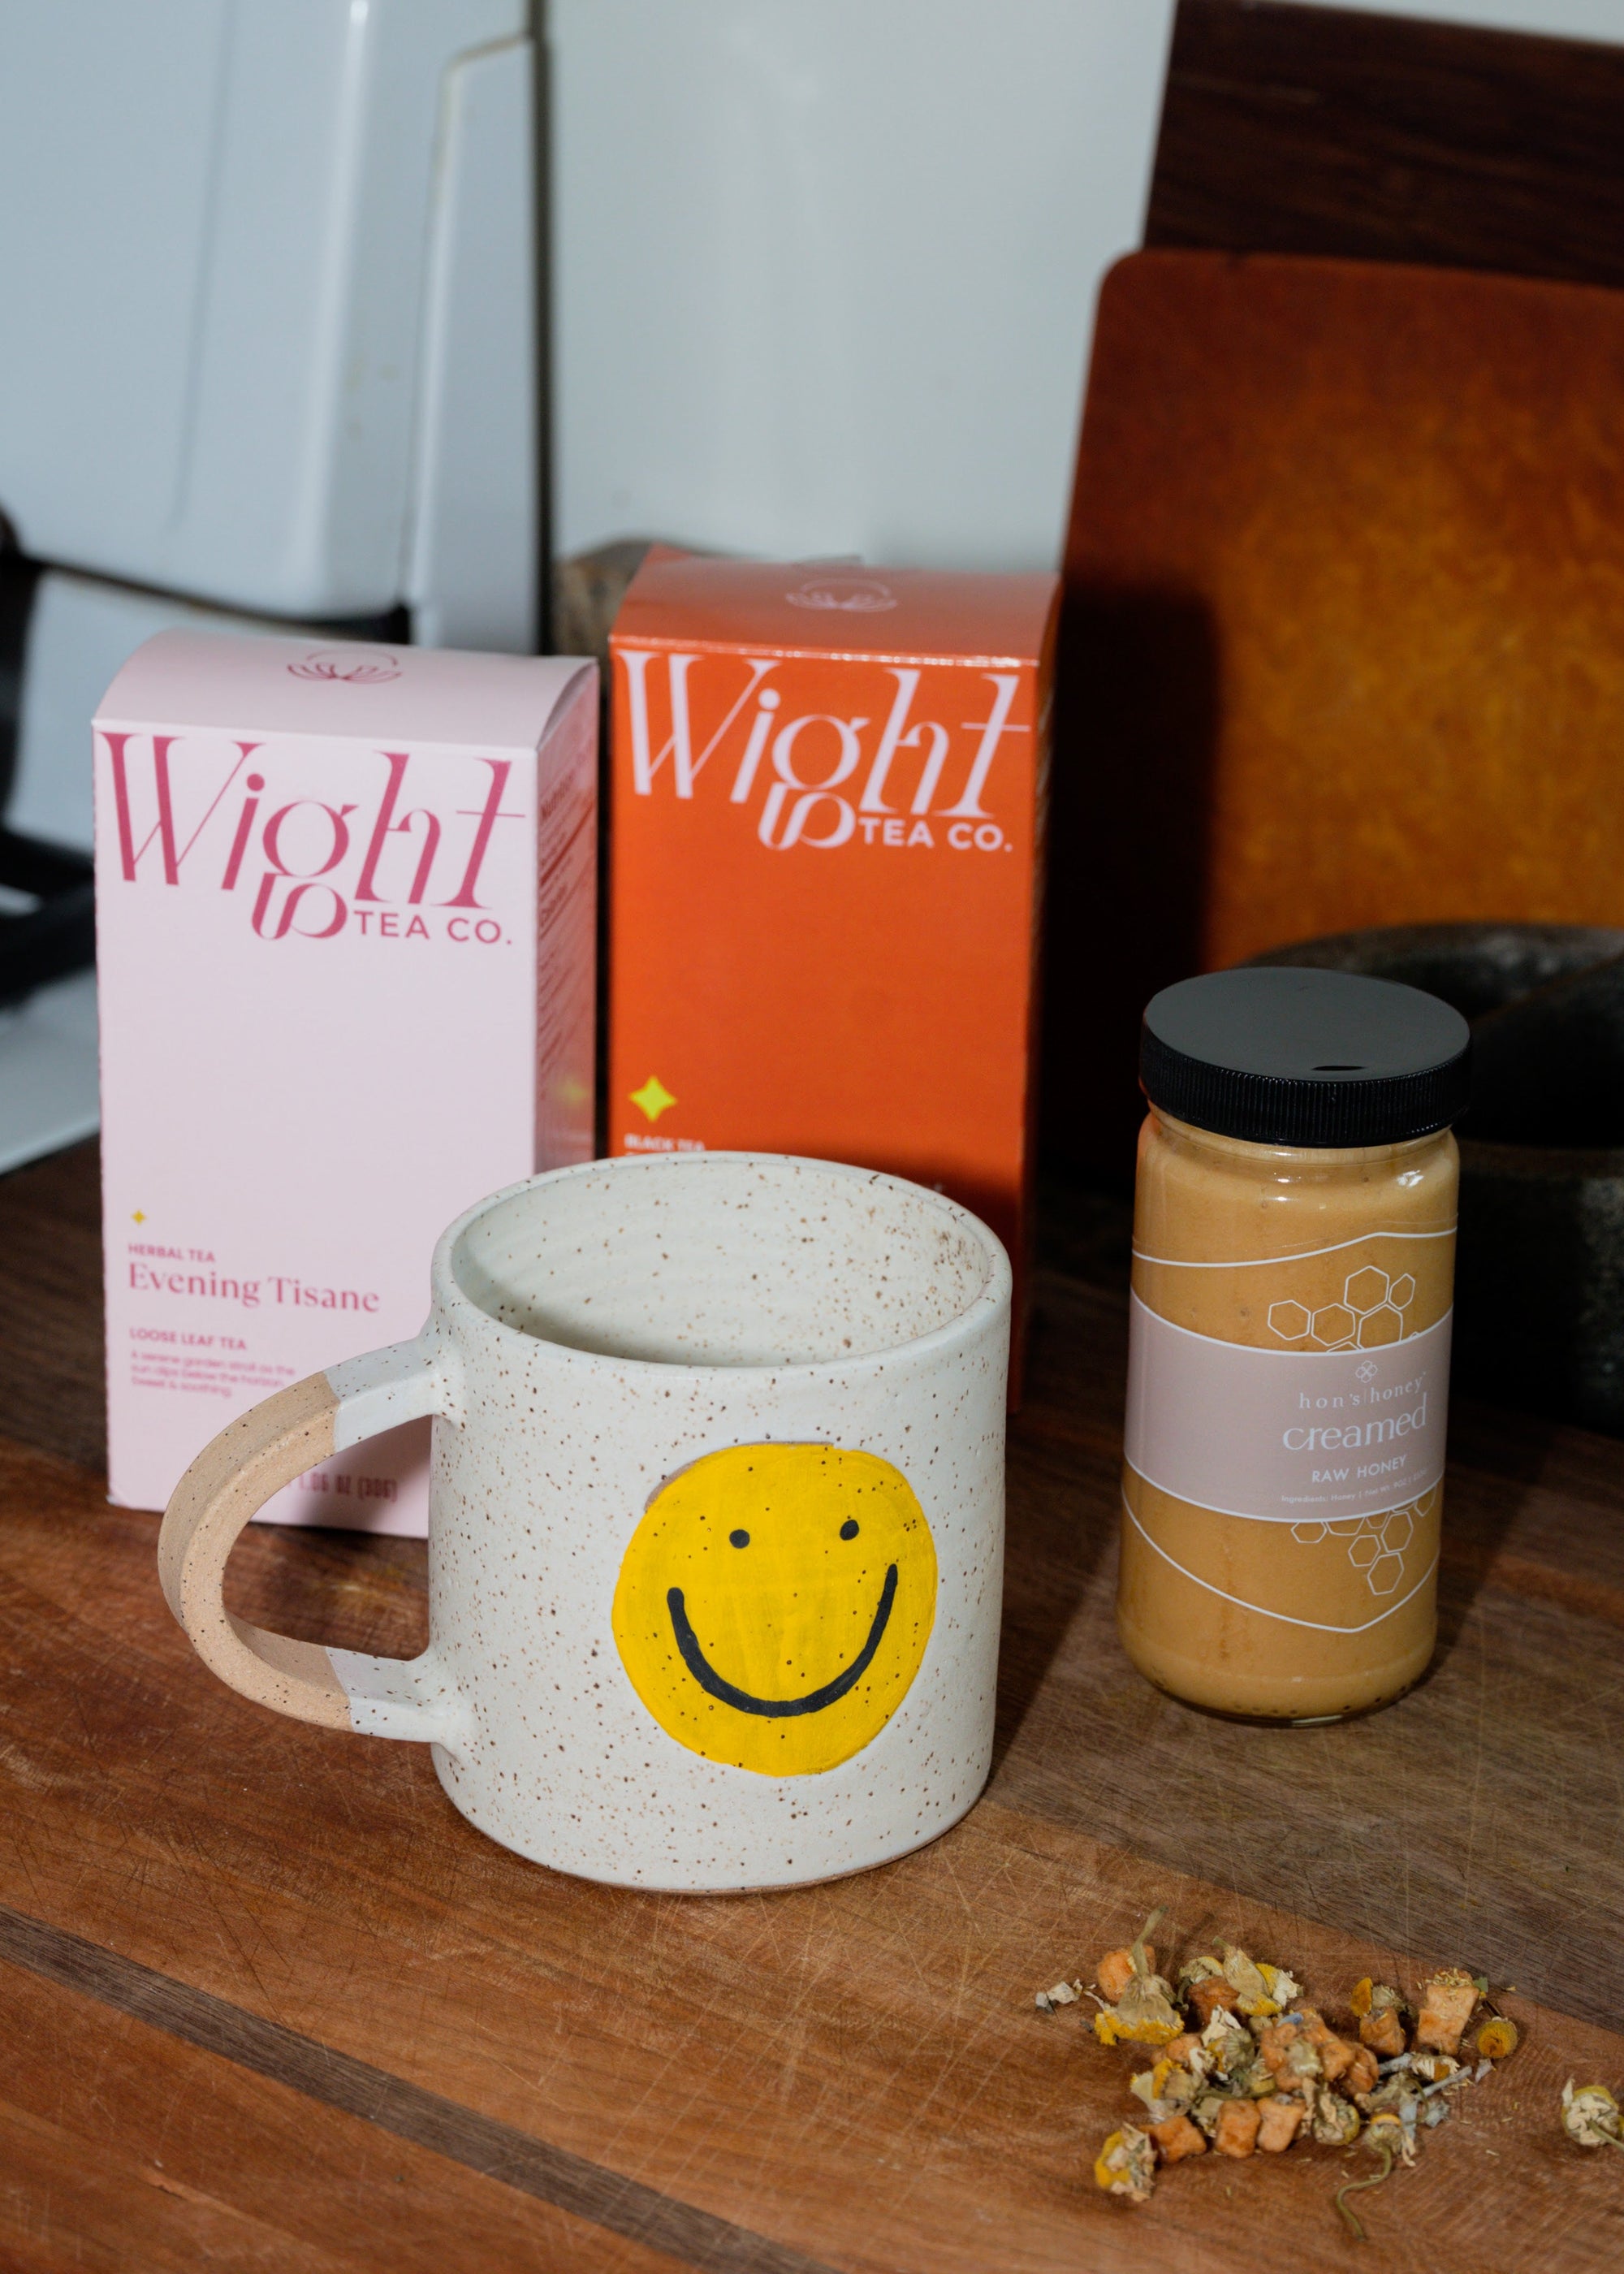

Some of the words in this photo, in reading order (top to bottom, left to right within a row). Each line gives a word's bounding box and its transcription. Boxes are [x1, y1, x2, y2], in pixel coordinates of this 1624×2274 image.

[617, 650, 1031, 852] Wight
[96, 730, 526, 940] Wight
[858, 817, 935, 849] TEA
[947, 821, 1013, 853] CO.
[353, 910, 430, 940] TEA
[447, 917, 513, 945] CO.
[624, 1132, 675, 1151] BLACK
[678, 1138, 706, 1152] TEA
[127, 1242, 184, 1261] HERBAL
[188, 1248, 216, 1264] TEA
[128, 1261, 261, 1309] Evening
[267, 1276, 381, 1313] Tisane
[128, 1327, 177, 1344] LOOSE
[180, 1333, 215, 1347] LEAF
[220, 1336, 247, 1351] TEA
[1299, 1391, 1361, 1410] hon's
[1370, 1376, 1424, 1404] honey
[1282, 1391, 1428, 1451] creamed
[1311, 1468, 1350, 1484] RAW
[1356, 1454, 1408, 1480] HONEY
[1281, 1494, 1328, 1504] Ingredients:
[1330, 1493, 1357, 1502] Honey
